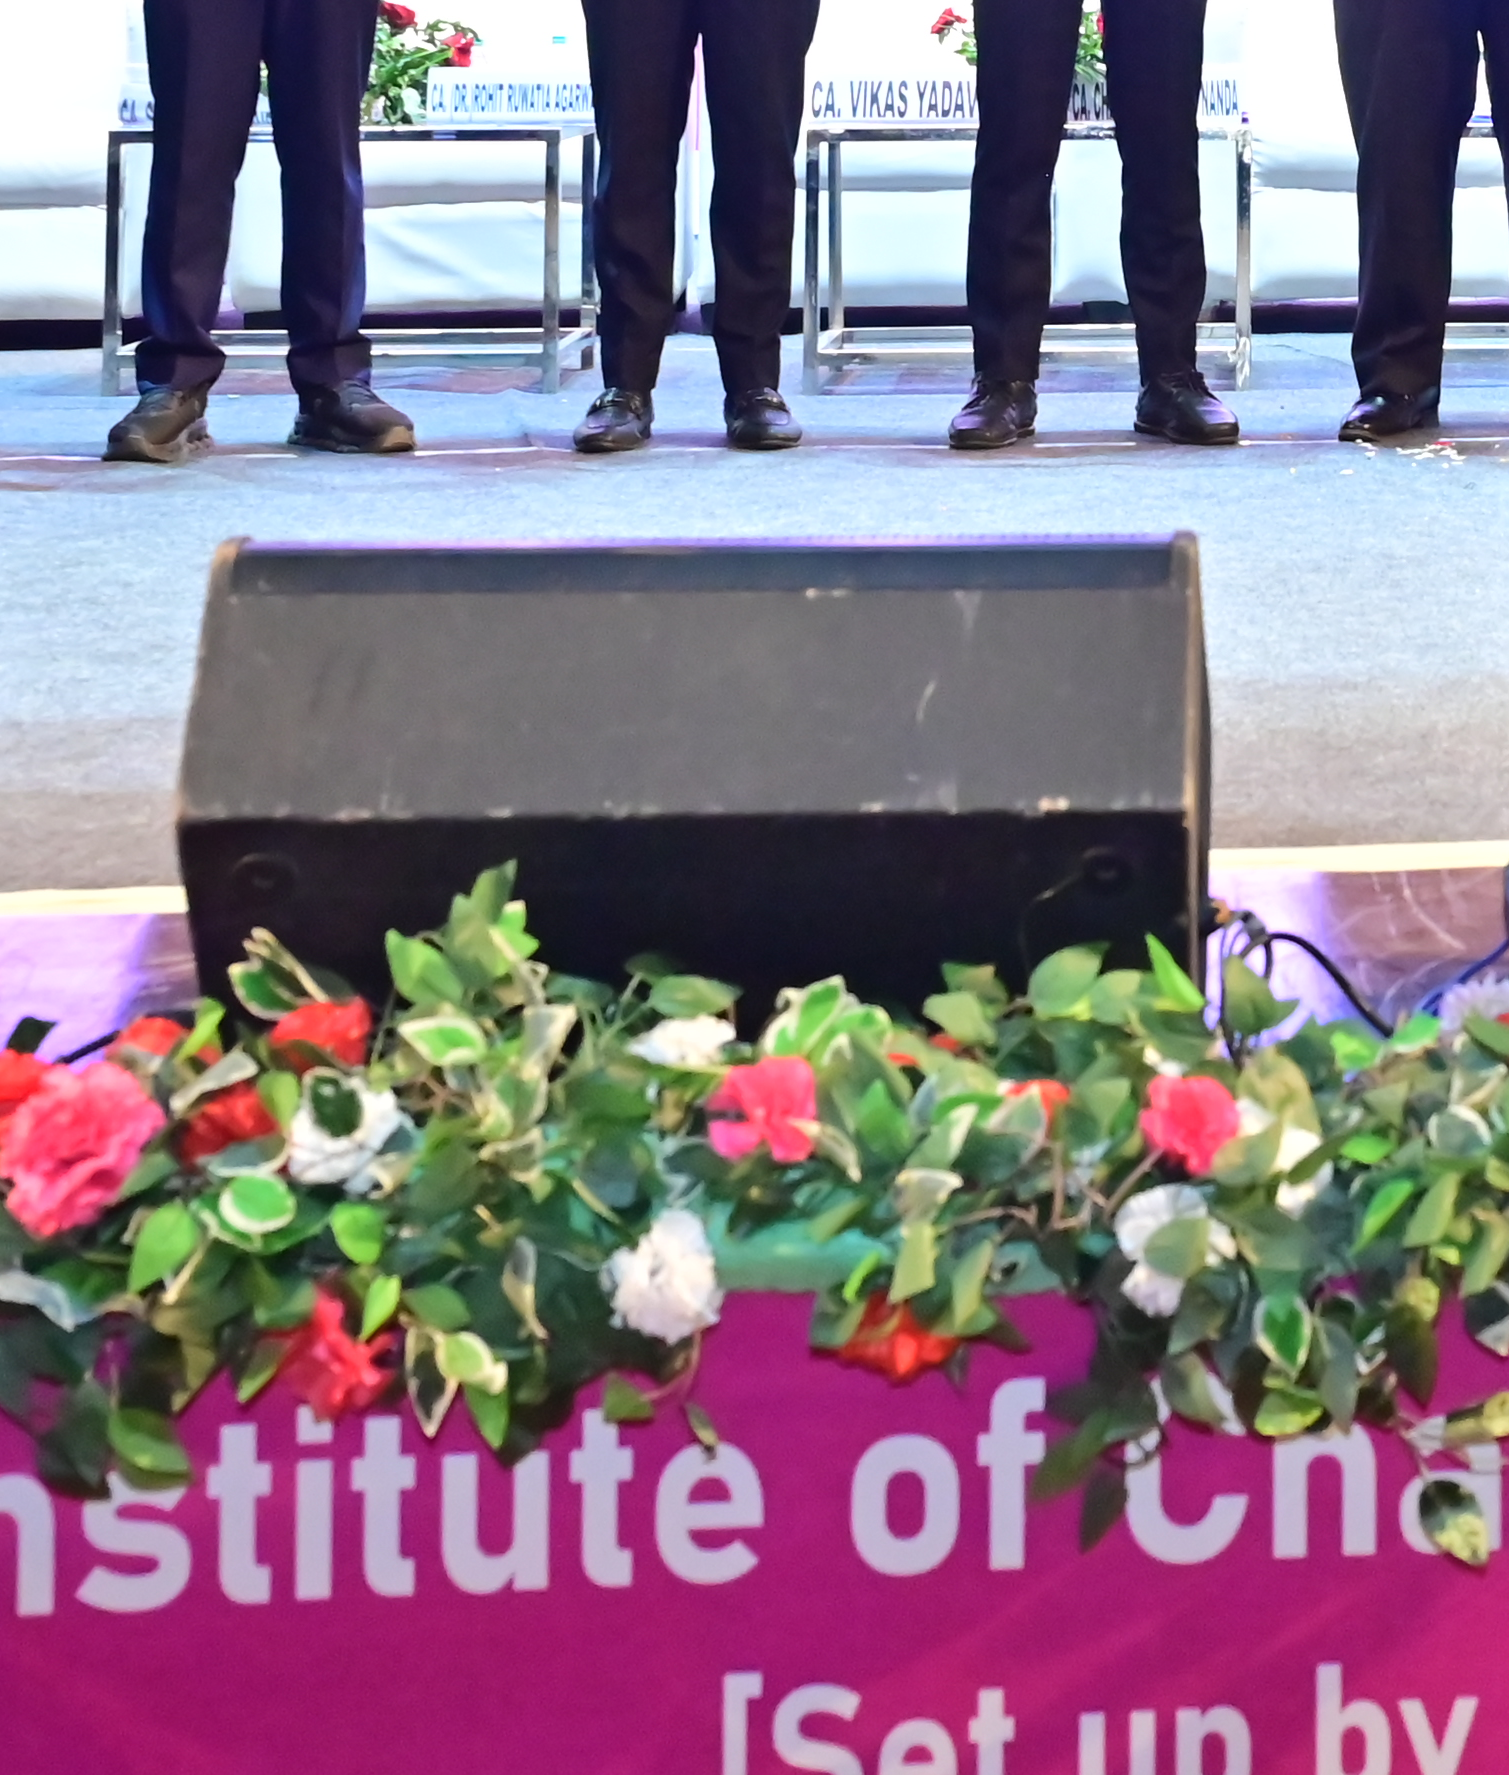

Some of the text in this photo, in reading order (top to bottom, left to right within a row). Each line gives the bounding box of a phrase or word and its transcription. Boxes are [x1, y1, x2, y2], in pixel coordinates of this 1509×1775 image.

[473, 83, 504, 113] ROHIT
[507, 83, 551, 113] RUWATIA
[811, 80, 979, 119] CA. VIKAS YADAV
[847, 1376, 1049, 1581] of
[719, 1669, 1016, 1775] [Set
[1316, 1660, 1478, 1775] by
